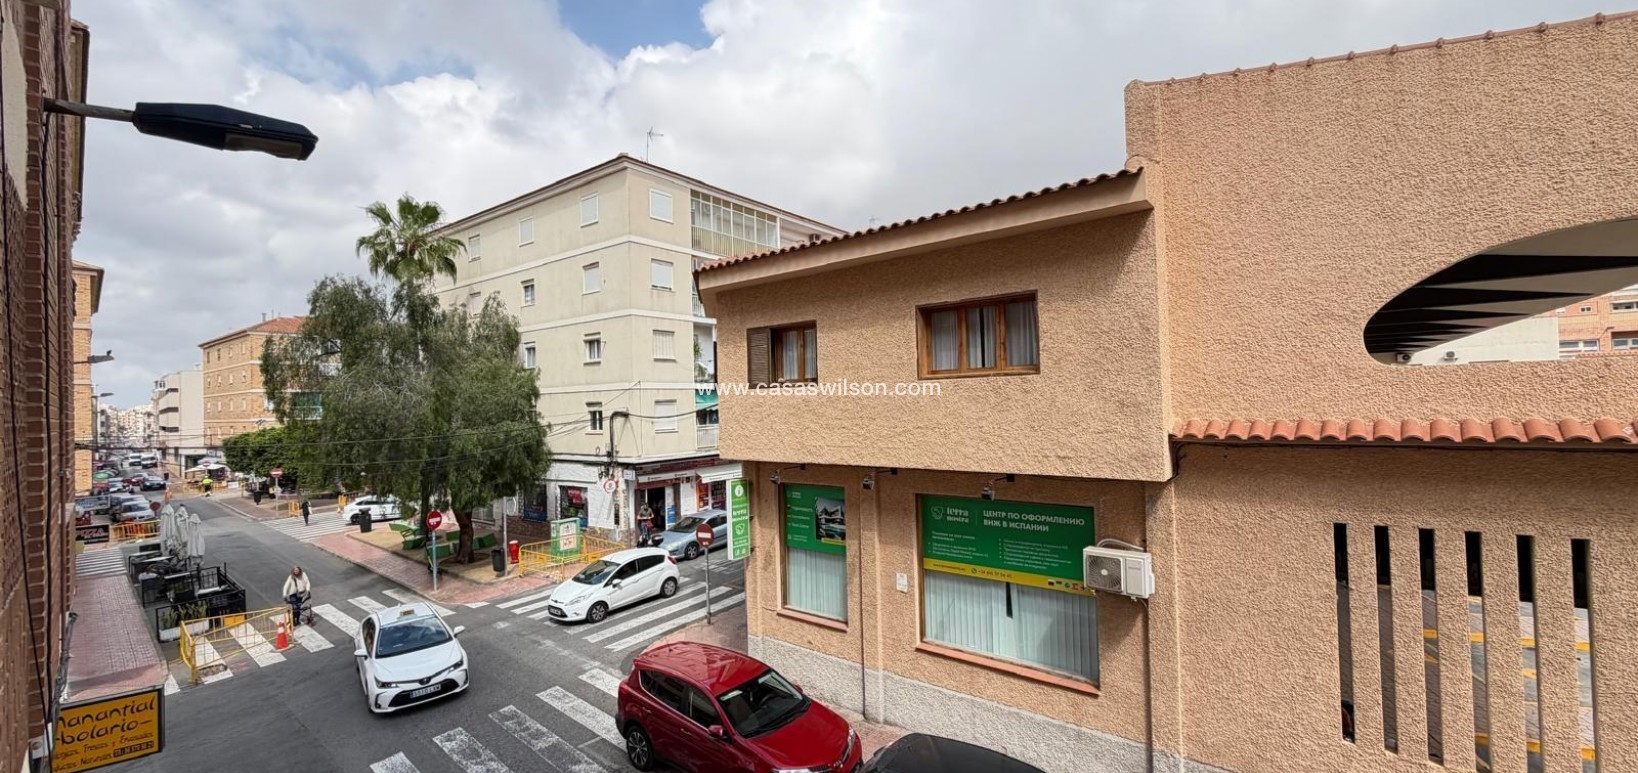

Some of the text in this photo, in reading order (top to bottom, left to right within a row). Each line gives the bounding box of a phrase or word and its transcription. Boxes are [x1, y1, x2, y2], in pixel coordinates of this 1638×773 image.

[983, 510, 1085, 526] ЦЕНТР ПО ОФОРМЛЕНИЮ
[1009, 521, 1049, 532] ИСПАНИИ
